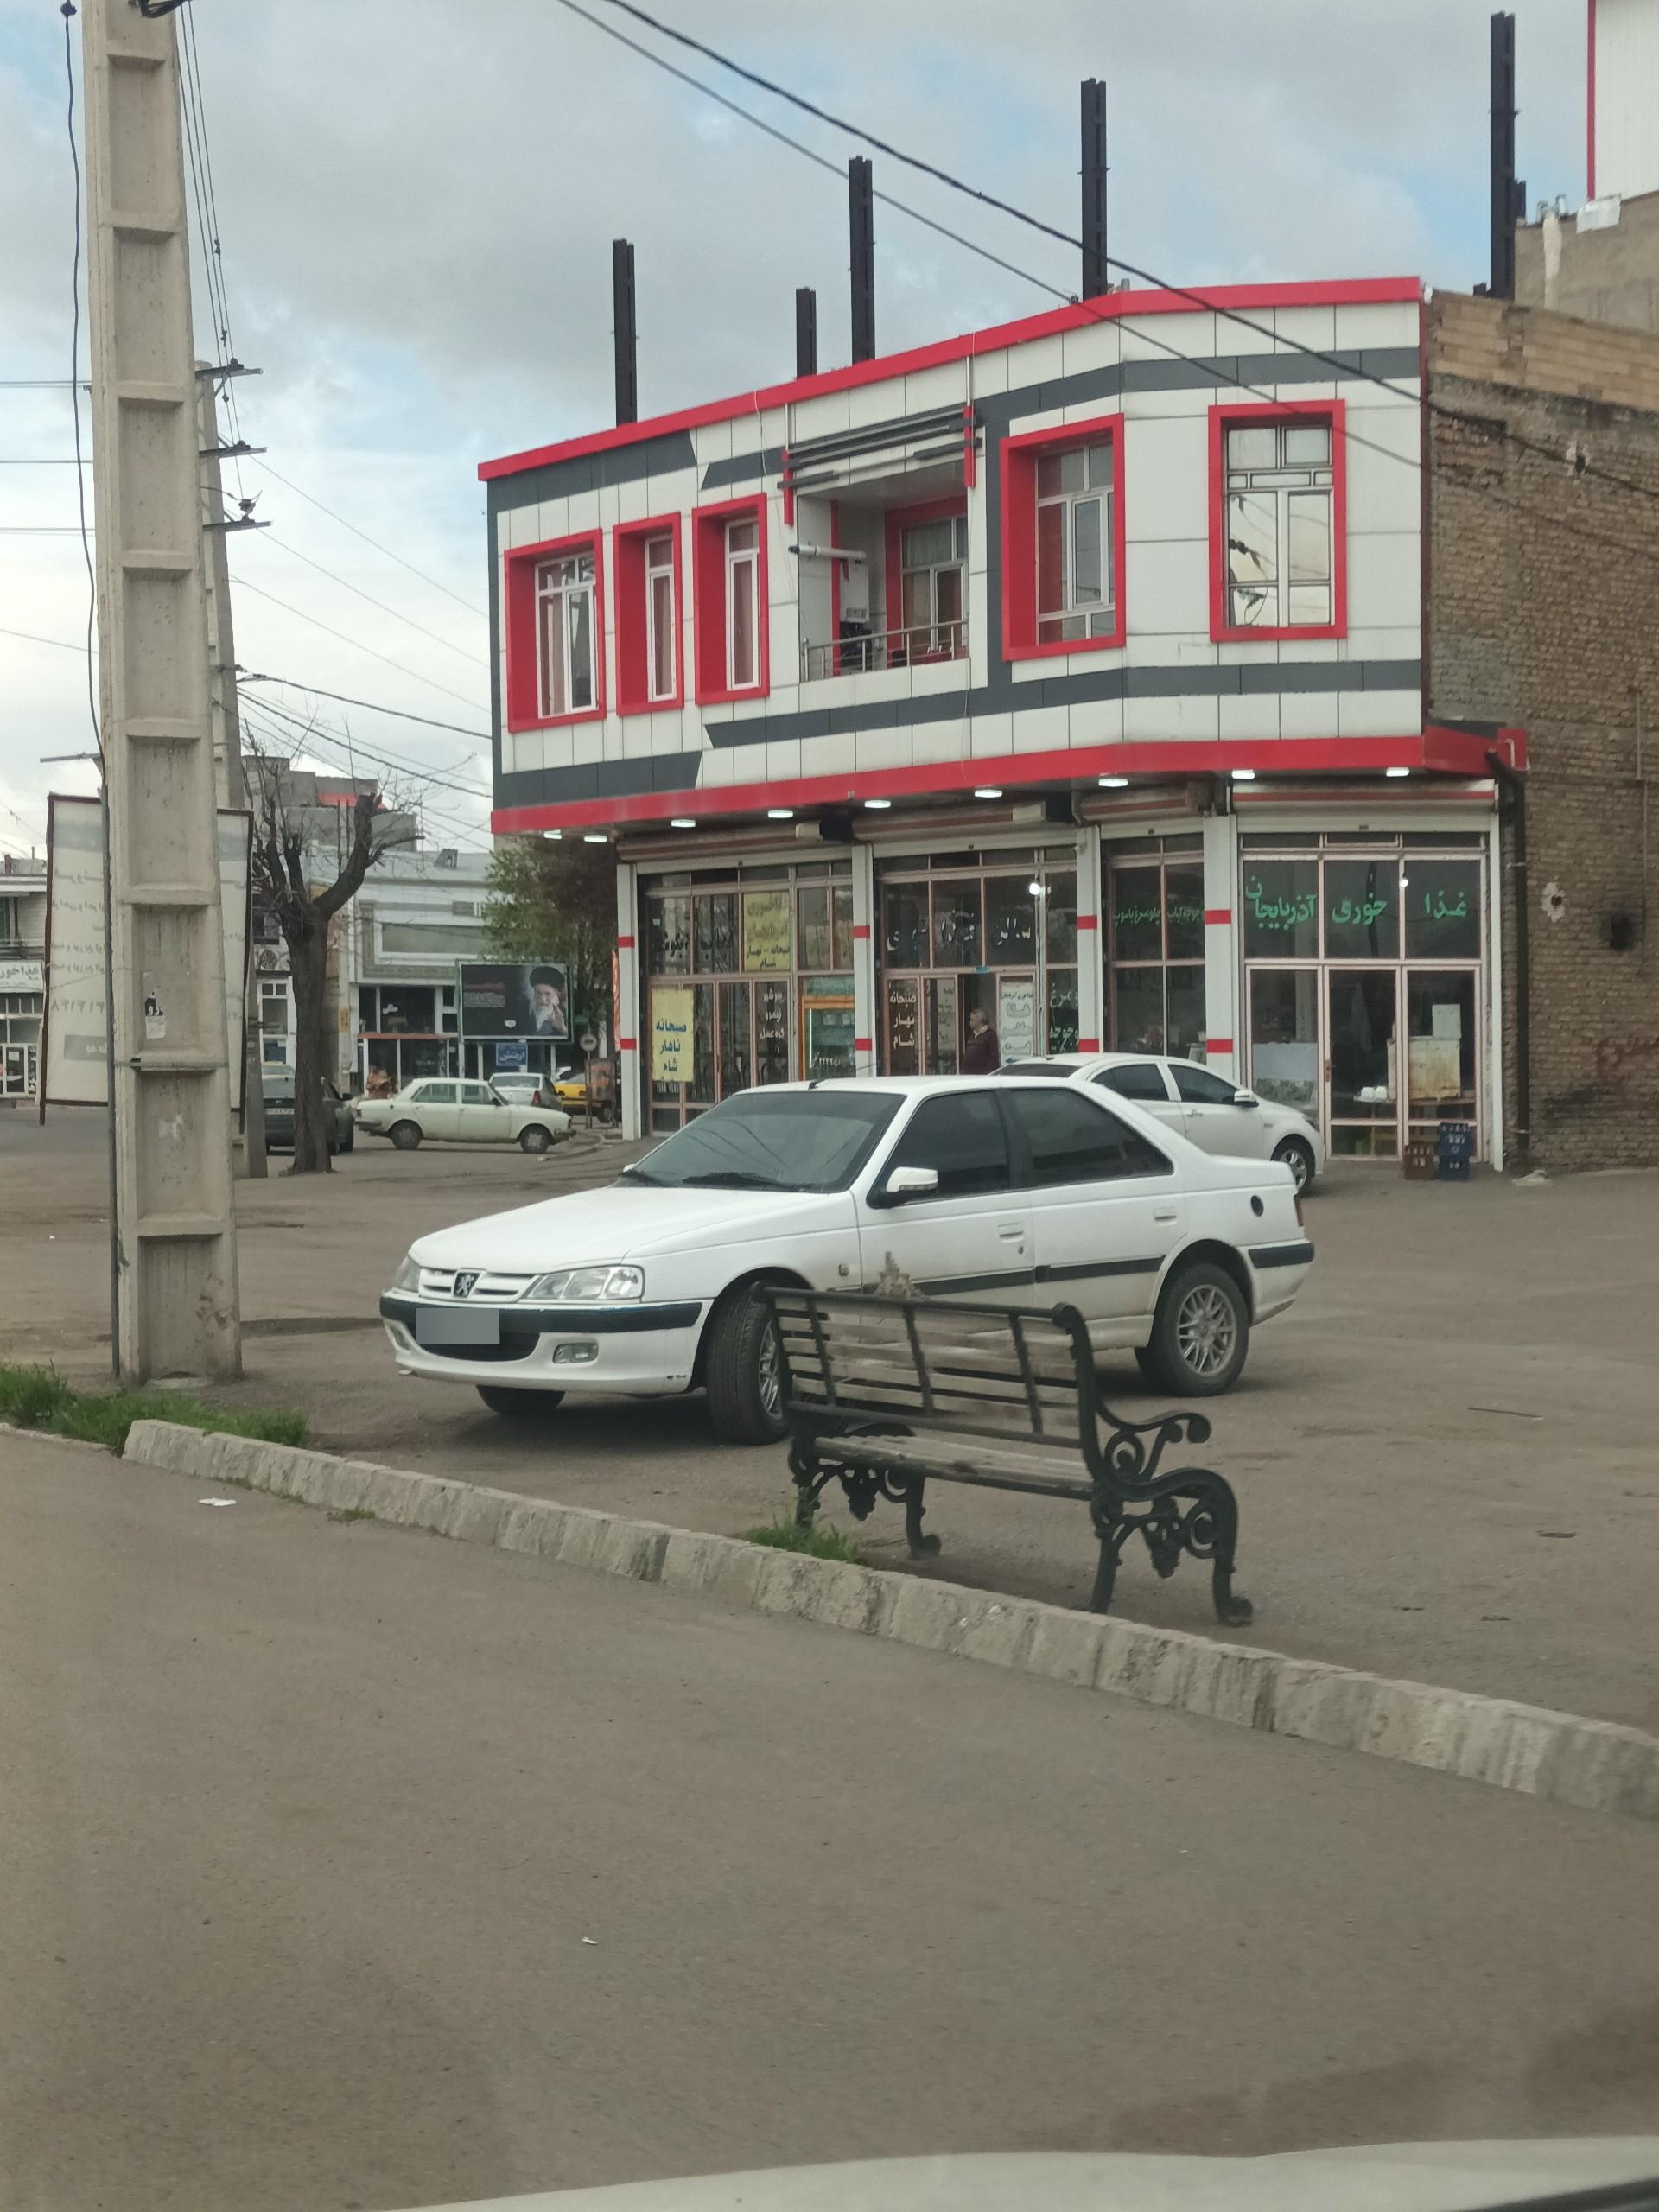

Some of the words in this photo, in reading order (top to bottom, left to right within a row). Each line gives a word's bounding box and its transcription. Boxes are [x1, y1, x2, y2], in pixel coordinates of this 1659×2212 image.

[1245, 875, 1317, 931] آذربایجان
[1332, 893, 1388, 925] خوری
[1424, 890, 1467, 919] غذا
[656, 1019, 687, 1036] صبحانه
[893, 1013, 915, 1029] نهار
[893, 1034, 915, 1050] شام
[663, 1058, 677, 1075] شام
